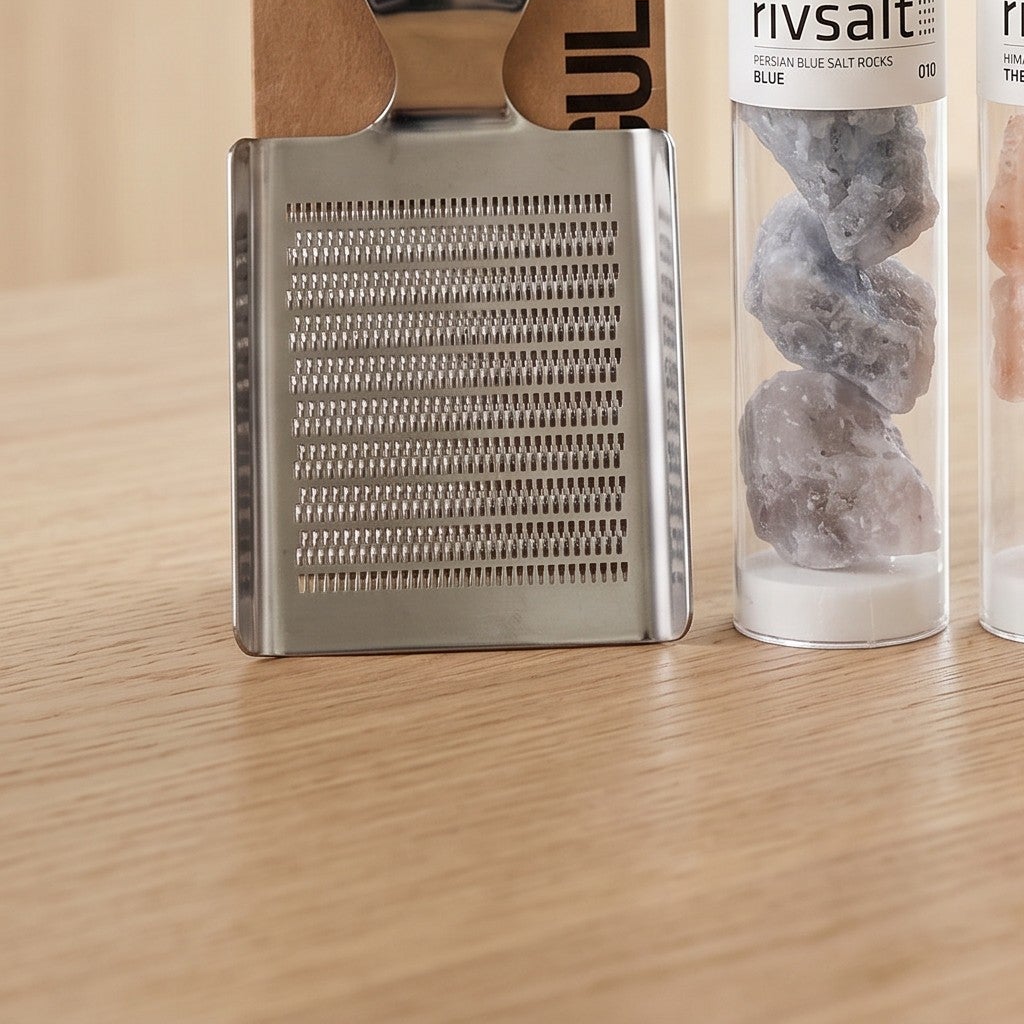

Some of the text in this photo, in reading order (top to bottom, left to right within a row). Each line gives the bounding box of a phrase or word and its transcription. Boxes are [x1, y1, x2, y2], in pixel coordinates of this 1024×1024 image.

[753, 54, 893, 69] PERSIAN BLUE SALT ROCKS
[753, 70, 785, 85] BLUE
[918, 62, 936, 79] 010
